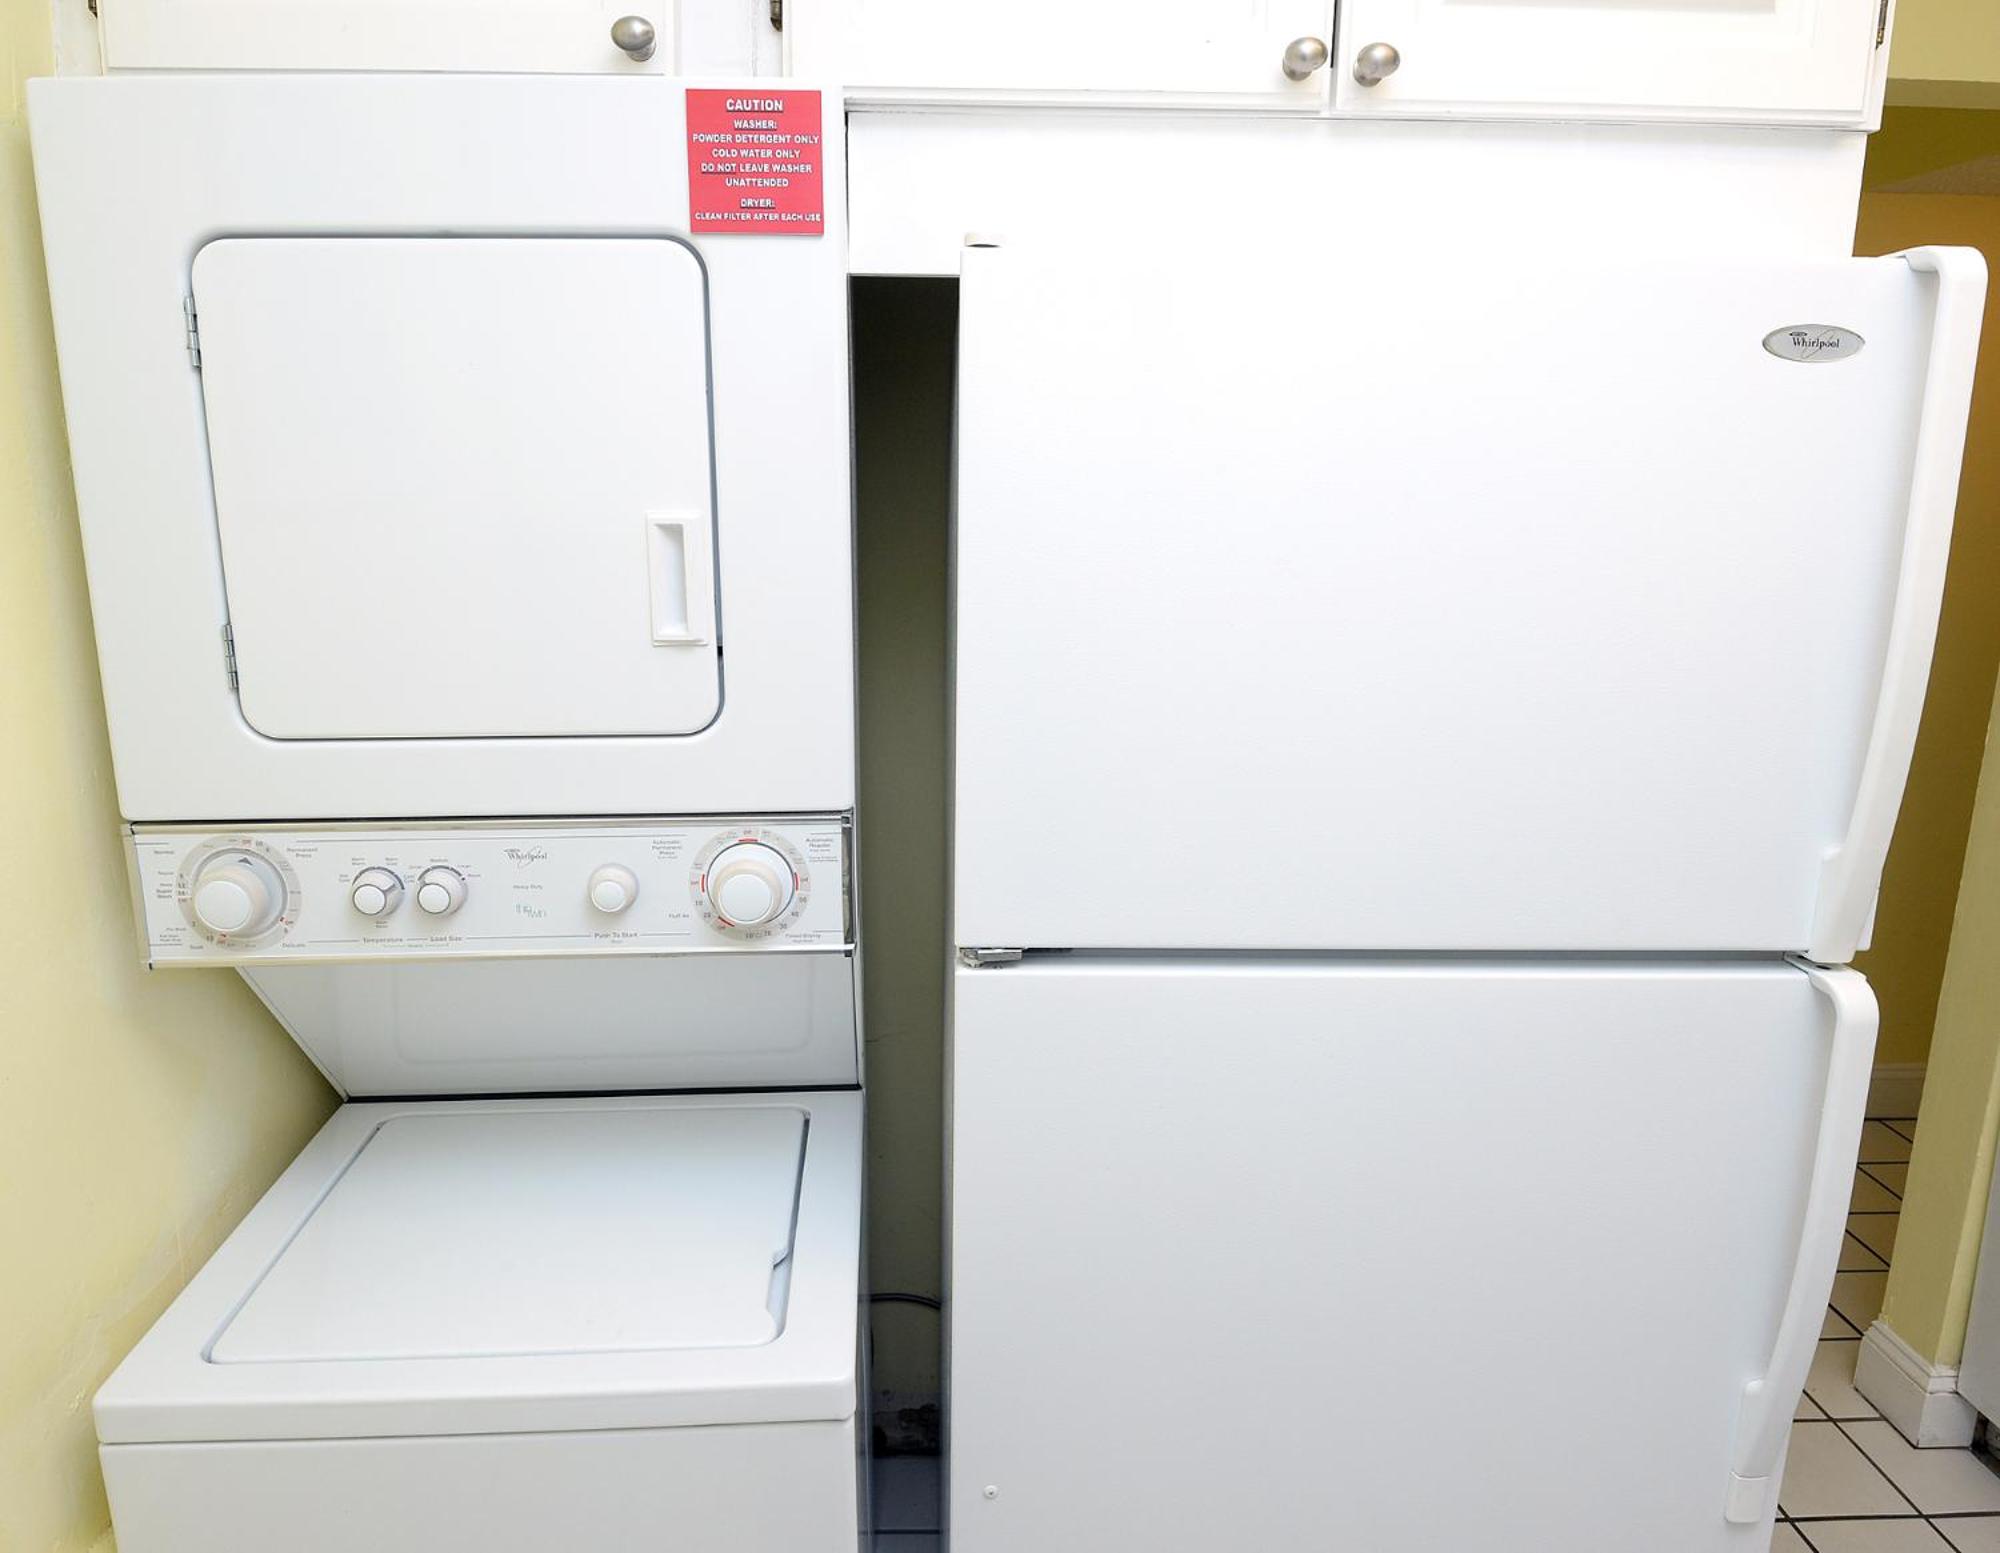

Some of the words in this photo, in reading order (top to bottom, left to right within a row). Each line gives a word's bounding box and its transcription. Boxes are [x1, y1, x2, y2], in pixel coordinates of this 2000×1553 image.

[726, 99, 784, 112] CAUTION
[734, 120, 778, 129] WASHER:
[692, 134, 732, 143] POWDER
[735, 134, 790, 144] DETERGENT
[794, 135, 819, 144] ONLY
[712, 148, 737, 158] COLD
[740, 149, 773, 158] WATER
[776, 150, 800, 158] ONLY
[701, 164, 714, 172] DO
[717, 164, 736, 172] NOT
[740, 164, 770, 173] LEAVE
[772, 164, 812, 173] WASHER
[725, 178, 789, 187] UNATTENDED
[740, 198, 776, 208] DRYER:
[753, 213, 780, 221] AFTER
[1792, 337, 1840, 350] Whirlpool
[507, 852, 548, 862] Whirlpool
